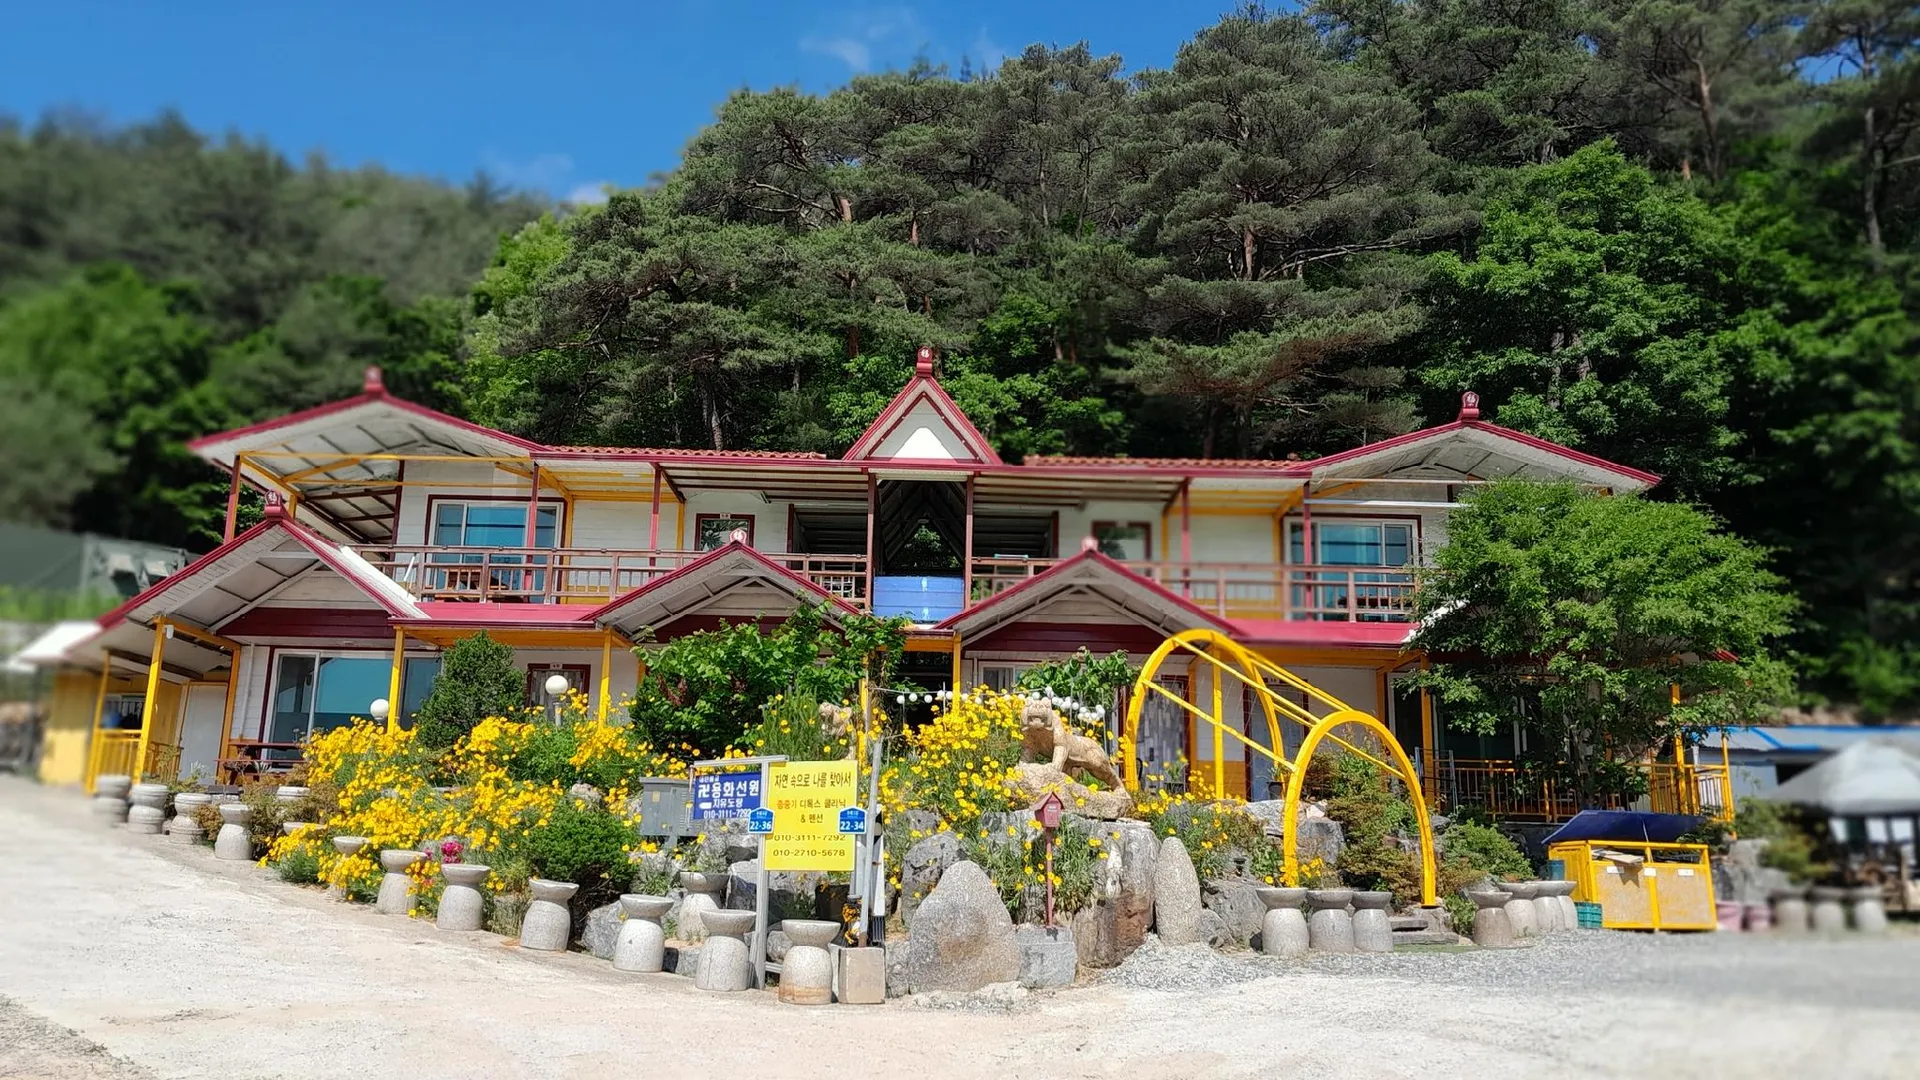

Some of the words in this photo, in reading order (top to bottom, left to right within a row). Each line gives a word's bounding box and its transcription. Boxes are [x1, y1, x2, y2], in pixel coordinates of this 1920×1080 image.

[775, 773, 788, 789] 자연
[791, 774, 810, 788] 속으로
[813, 772, 828, 788] 나를
[830, 771, 852, 787] 찾아서
[800, 799, 821, 809] 디톡스
[824, 798, 846, 809] 클리닉
[800, 814, 806, 823] &
[809, 813, 823, 823] 펜션
[750, 821, 772, 830] 22-36
[840, 821, 864, 830] 22-34
[773, 849, 846, 857] 010-2710-5678
